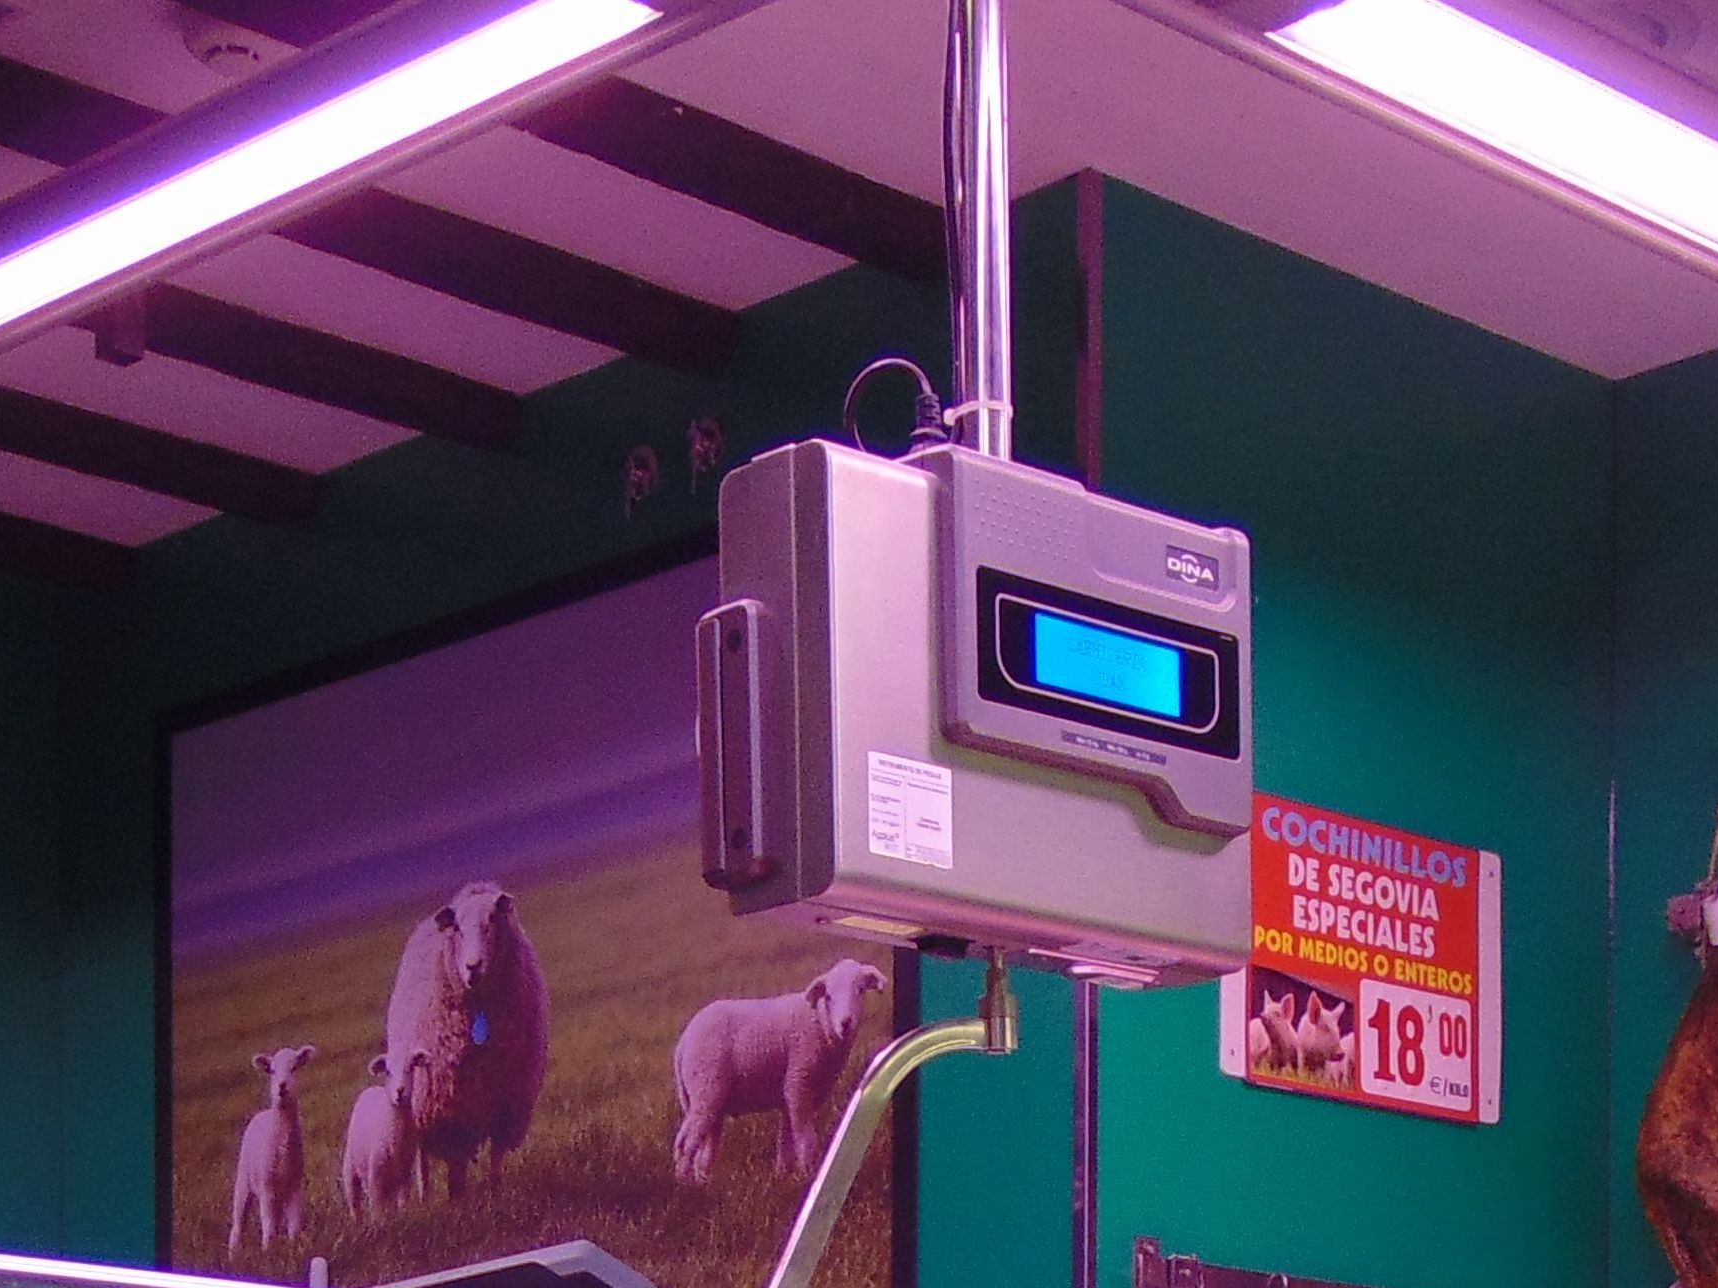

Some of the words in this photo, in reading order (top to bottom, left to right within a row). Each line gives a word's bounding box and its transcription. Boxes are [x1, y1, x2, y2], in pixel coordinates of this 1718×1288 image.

[1167, 556, 1215, 582] DINA
[1262, 805, 1469, 889] COCHINILLOS
[1288, 852, 1321, 892] DE
[1328, 863, 1441, 922] SEGOVIA
[1254, 924, 1294, 956] POR
[1298, 936, 1369, 974] MEDIOS
[1374, 958, 1390, 977] O
[1394, 959, 1473, 996] ENTEROS
[1293, 894, 1436, 959] ESPECIALES
